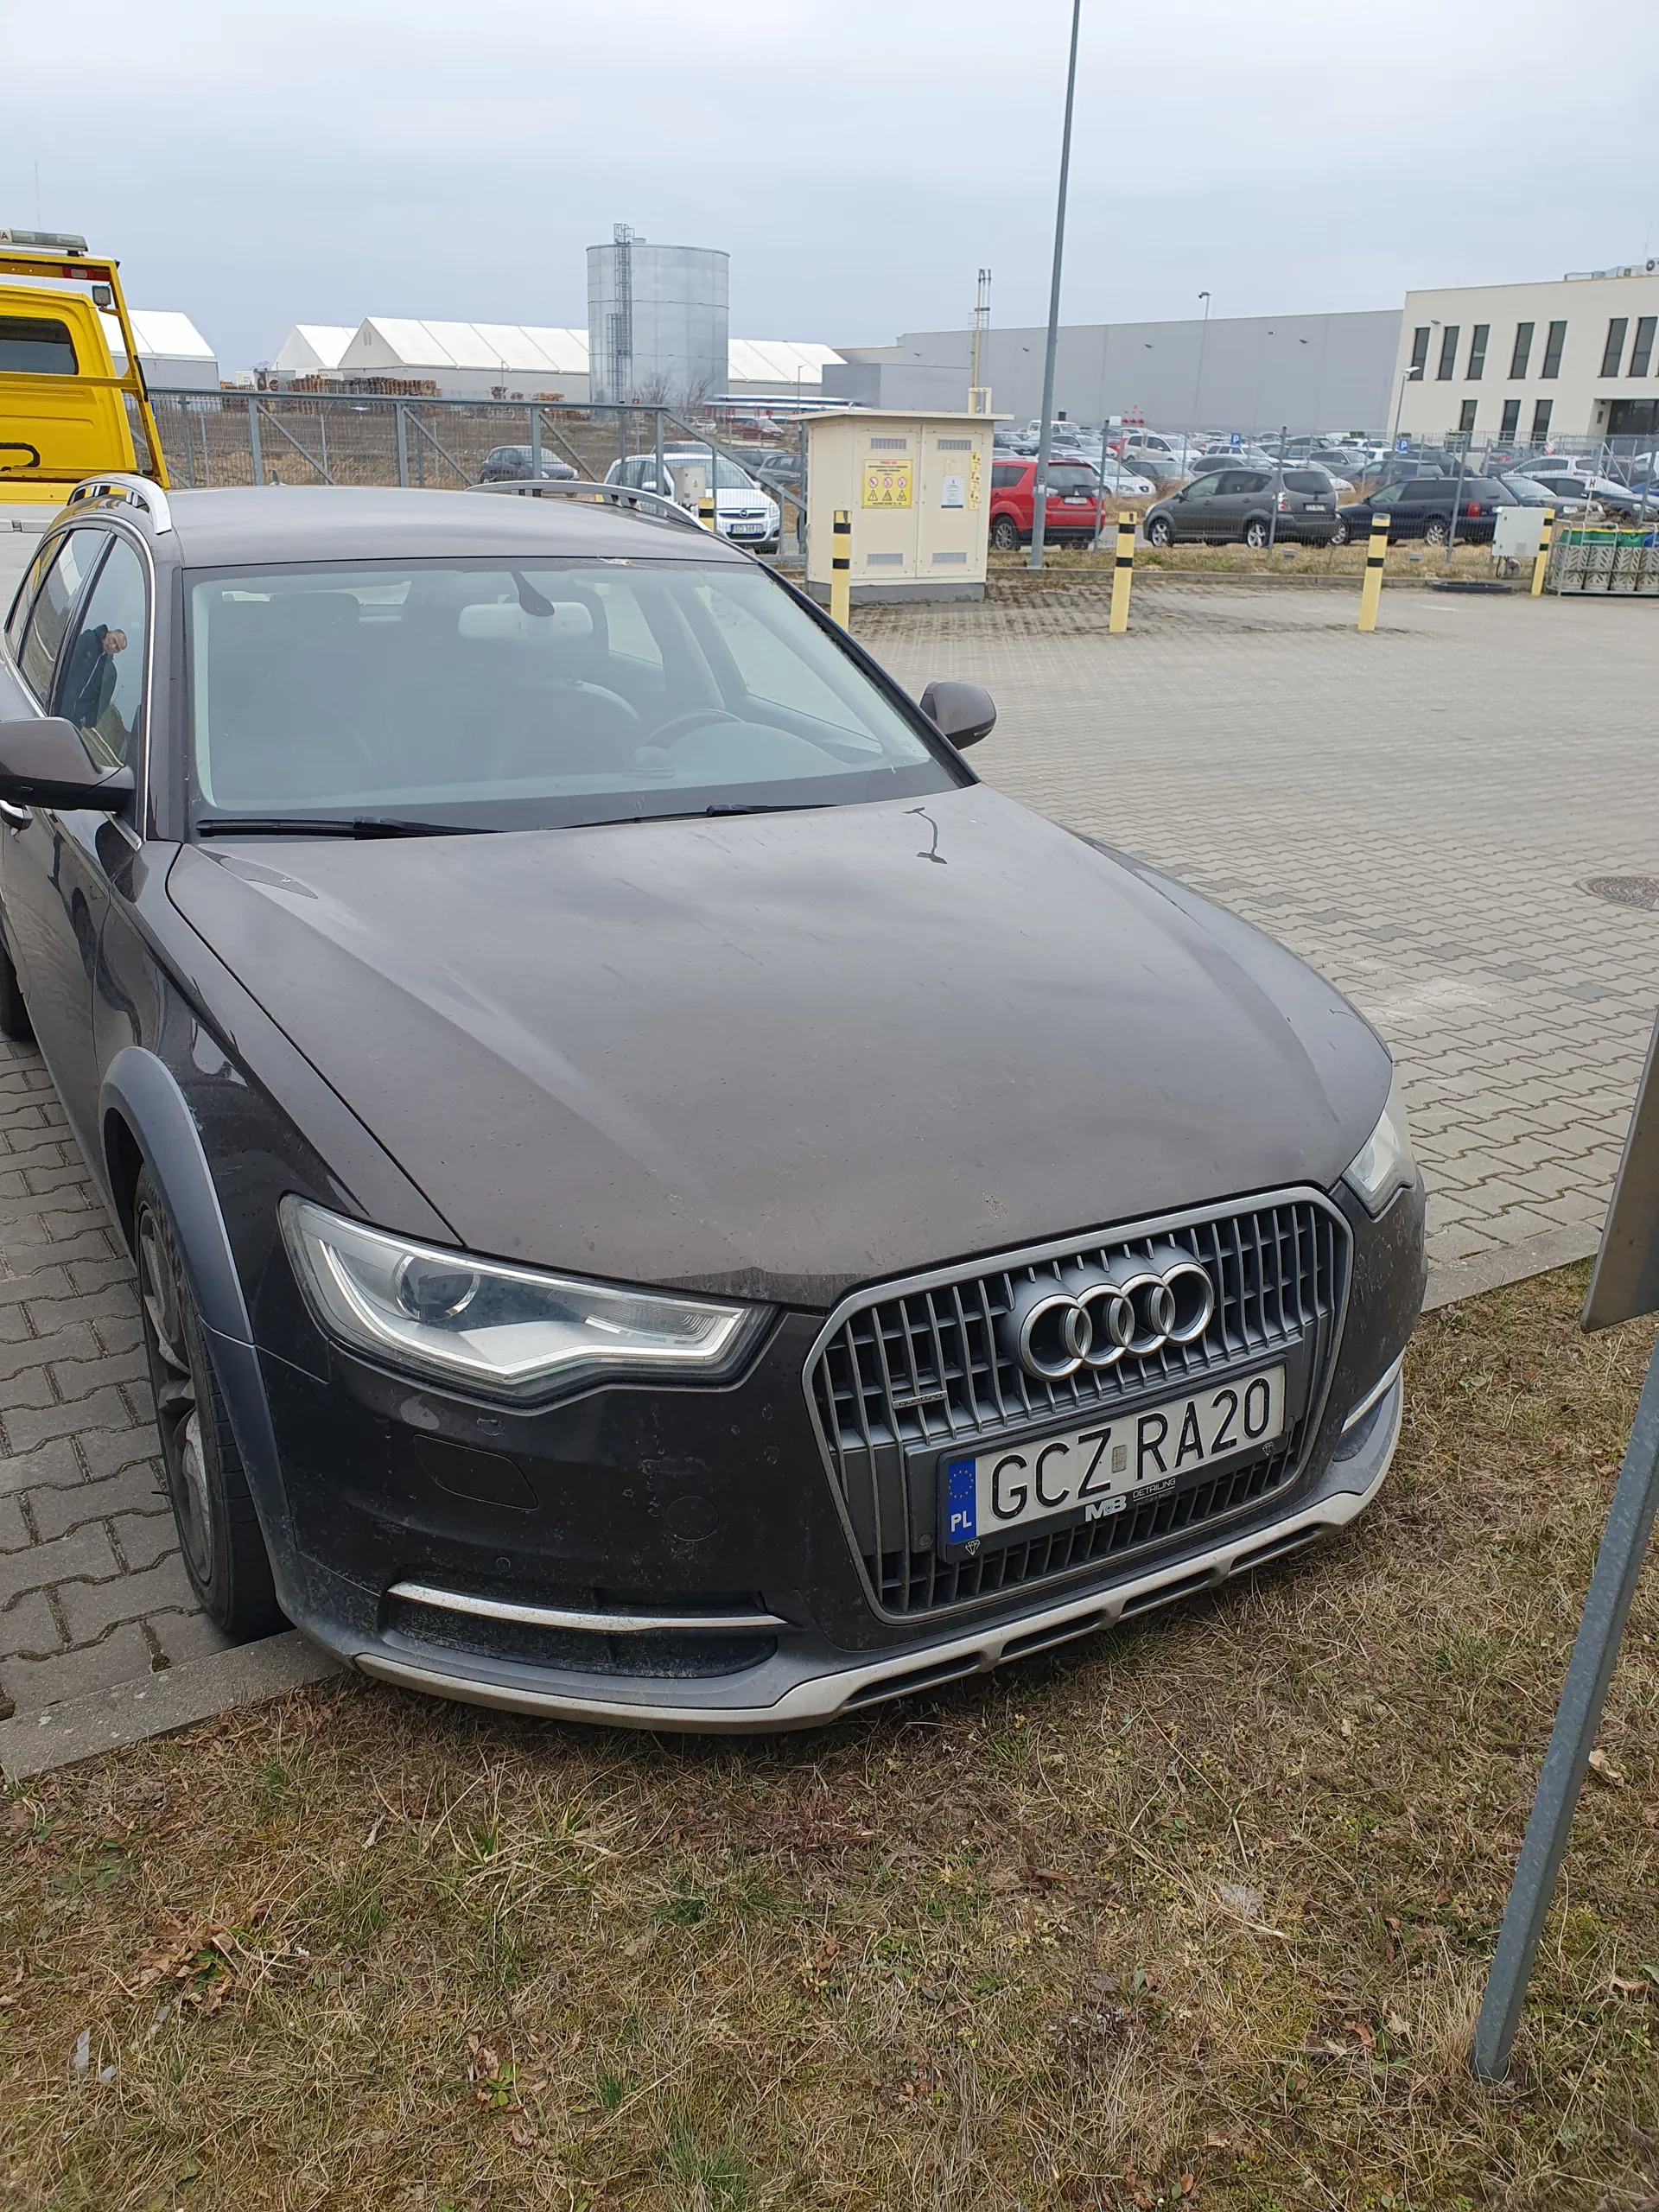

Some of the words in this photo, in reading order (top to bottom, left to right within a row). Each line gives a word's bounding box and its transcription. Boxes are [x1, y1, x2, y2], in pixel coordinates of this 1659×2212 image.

[899, 1394, 943, 1407] quattro
[991, 1427, 1112, 1520] GCZ
[1135, 1377, 1271, 1481] RA20
[1133, 1478, 1176, 1499] DETAILING
[950, 1510, 973, 1533] PL
